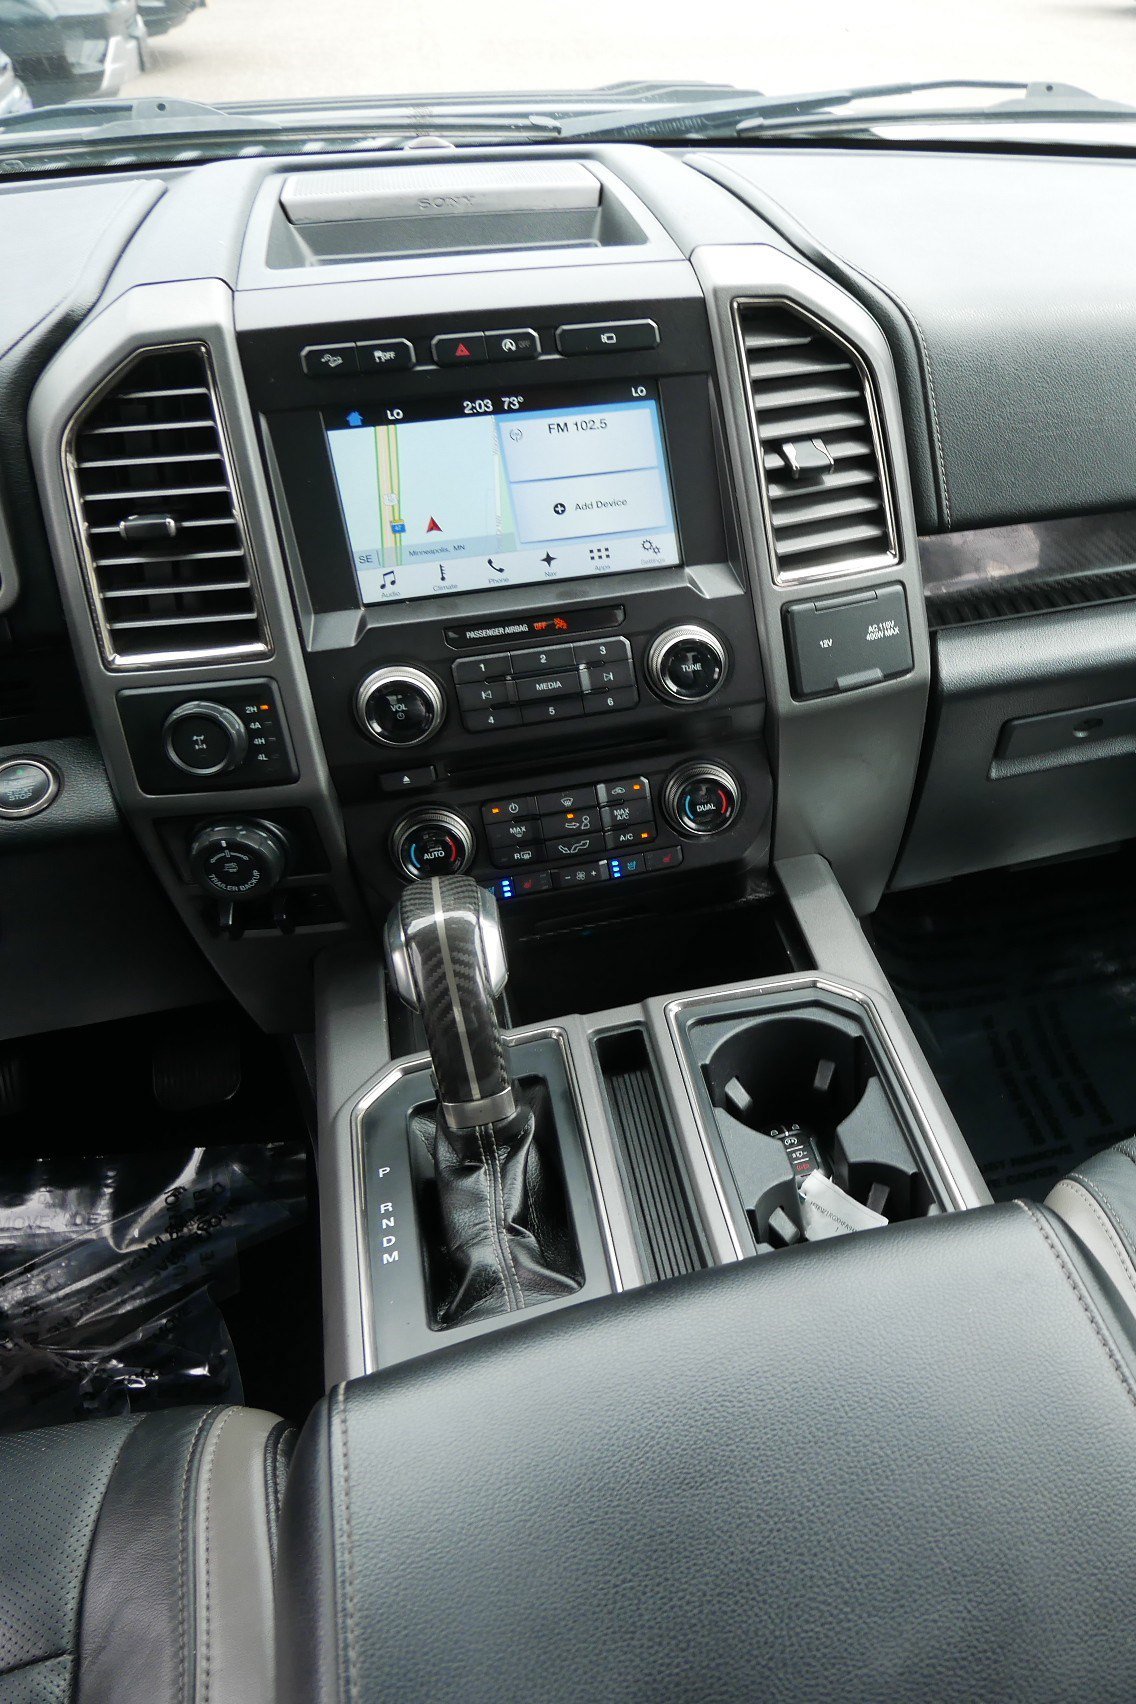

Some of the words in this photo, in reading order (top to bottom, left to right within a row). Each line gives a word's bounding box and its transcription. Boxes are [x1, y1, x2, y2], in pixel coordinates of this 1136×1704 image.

[381, 350, 396, 361] OFF
[630, 386, 647, 397] LO
[463, 398, 493, 414] 2:03
[386, 408, 404, 420] LO
[547, 421, 569, 435] FM
[572, 417, 608, 432] 102.5
[574, 502, 594, 512] Add
[596, 497, 628, 509] Device
[453, 543, 466, 552] MN
[358, 554, 373, 564] SE
[640, 556, 666, 567] Settings
[594, 562, 611, 572] Apps
[544, 570, 557, 578] Nav
[487, 575, 510, 585] Phone
[432, 582, 458, 592] Climate
[380, 589, 401, 599] Audio
[879, 619, 895, 630] 110V
[466, 627, 505, 639] PASSENGER
[504, 623, 529, 635] AIRBAG
[533, 621, 548, 631] OFF
[884, 625, 900, 637] MAX
[819, 638, 833, 648] 12V
[599, 645, 607, 654] 3
[539, 654, 547, 663] 2
[479, 663, 486, 672] 1
[681, 662, 703, 673] TUNE
[535, 680, 563, 691] MEDIA
[606, 697, 614, 706] 6
[245, 705, 258, 714] 2H
[390, 703, 408, 712] VOL
[548, 707, 556, 715] 5
[487, 715, 495, 724] 4
[249, 721, 262, 729] 4A
[253, 737, 266, 745] 4H
[257, 753, 269, 761] 4L
[613, 807, 630, 817] MAX
[695, 802, 717, 813] DUAL
[509, 825, 527, 835] MAX
[619, 833, 634, 842] A/C
[423, 850, 445, 860] AUTO
[208, 873, 239, 892] TRAILER
[239, 869, 261, 892] BACKUP
[379, 1166, 391, 1178] P
[380, 1202, 393, 1214] R
[382, 1216, 395, 1229] N
[383, 1235, 396, 1248] D
[383, 1250, 399, 1265] M
